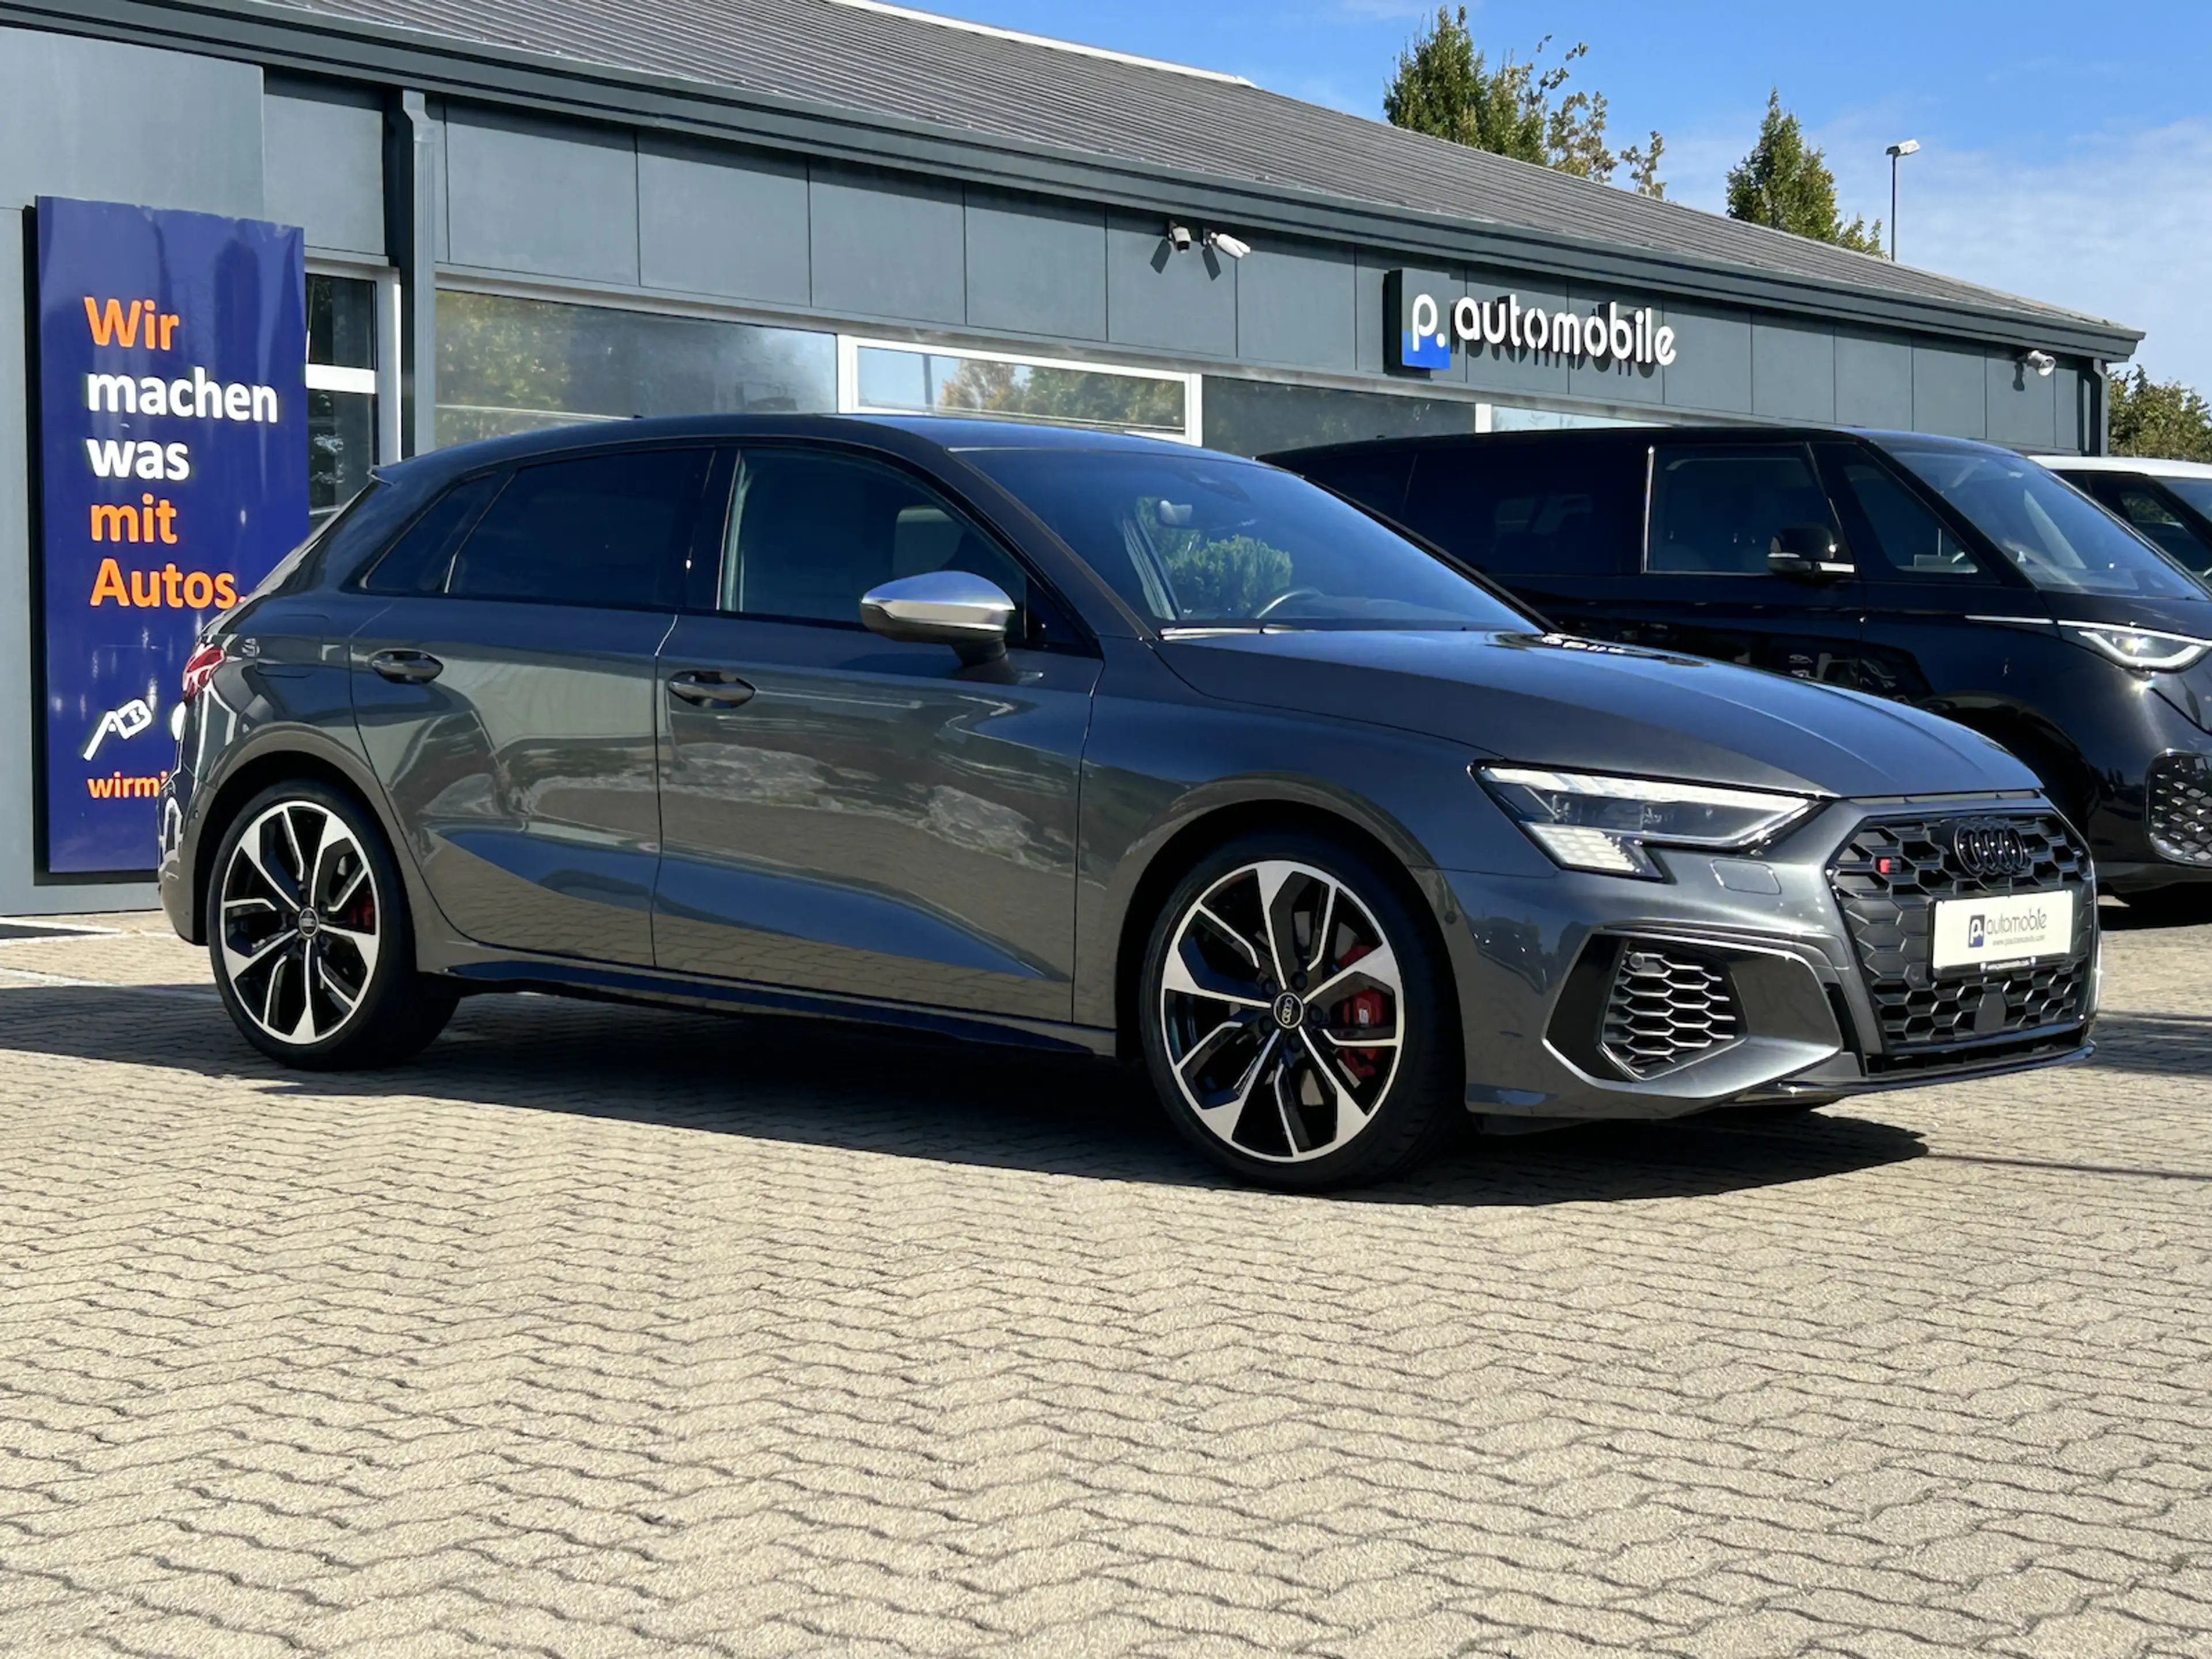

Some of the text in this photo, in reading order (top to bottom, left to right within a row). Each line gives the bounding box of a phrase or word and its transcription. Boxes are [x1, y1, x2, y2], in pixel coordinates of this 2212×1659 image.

[84, 296, 179, 350] Wir
[1455, 294, 1677, 366] automobile
[86, 366, 278, 422] machen
[86, 438, 191, 480] was
[90, 493, 178, 543] mit
